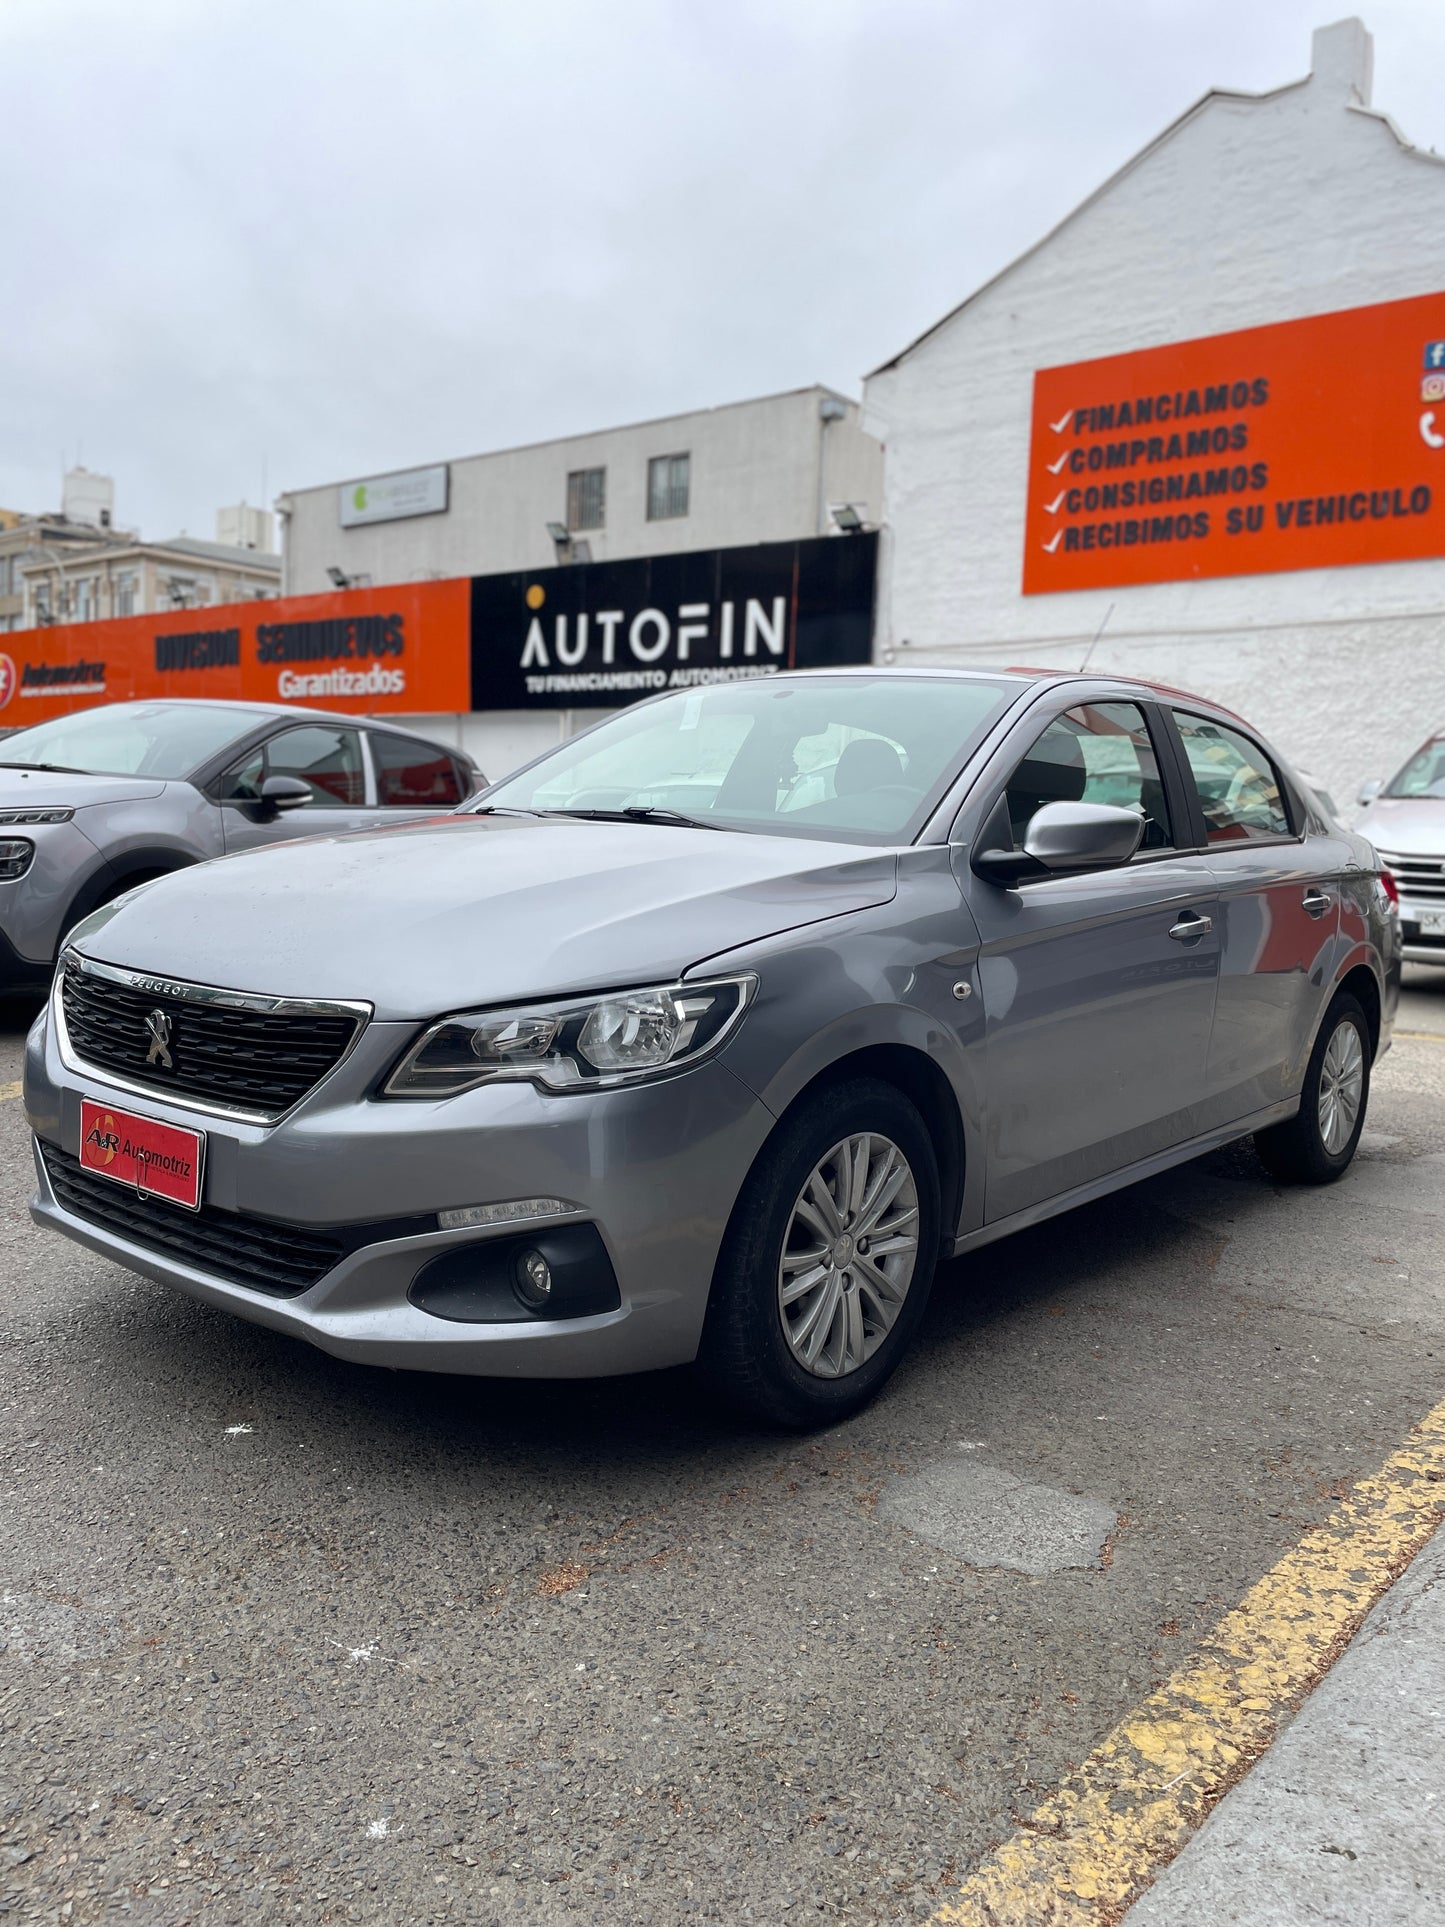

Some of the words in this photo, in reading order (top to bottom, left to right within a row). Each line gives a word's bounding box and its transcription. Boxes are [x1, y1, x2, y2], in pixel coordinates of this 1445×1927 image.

[1072, 377, 1270, 435] FINANCIAMOS
[1069, 422, 1249, 474] COMPRAMOS
[1064, 462, 1269, 515] CONSIGNAMOS
[1063, 511, 1209, 553] RECIBIMOS
[1225, 504, 1265, 535] SU
[1275, 485, 1432, 529] VEHICULO
[256, 613, 404, 664] SEMINUEVOS
[519, 596, 786, 668] AUTOFIN
[277, 662, 406, 698] Garantizados
[525, 675, 545, 693] TU
[131, 975, 190, 997] PEUGEOT
[86, 1129, 120, 1153] A&R
[122, 1139, 191, 1177] Automotriz
